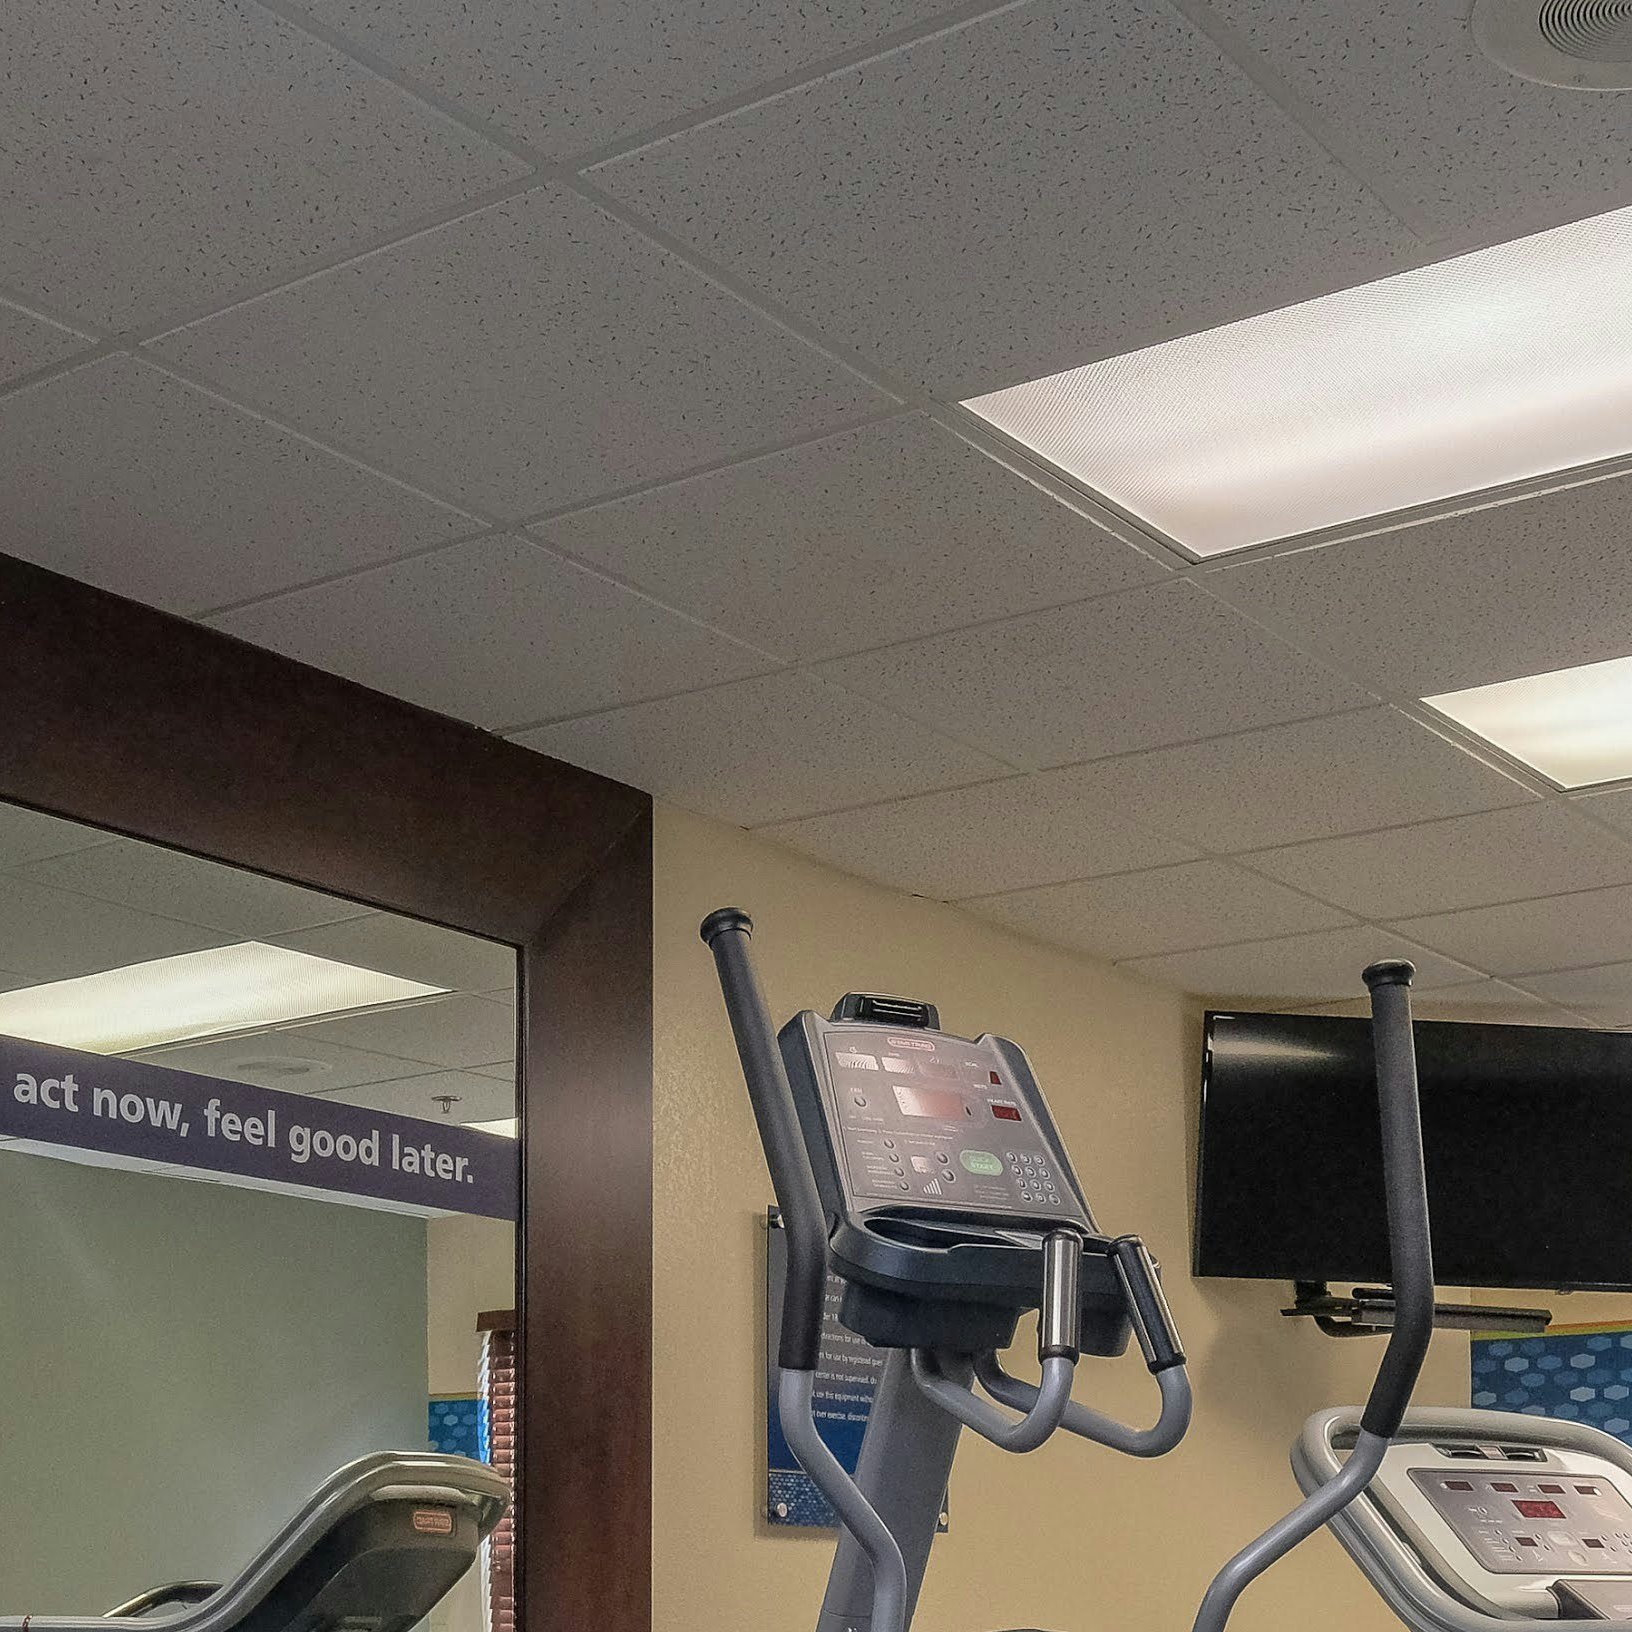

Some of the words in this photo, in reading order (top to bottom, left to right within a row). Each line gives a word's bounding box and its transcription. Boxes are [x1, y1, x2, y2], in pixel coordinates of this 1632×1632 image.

[13, 1071, 79, 1113] act
[93, 1087, 189, 1138] now,
[204, 1098, 276, 1148] feel
[288, 1124, 380, 1164] good
[392, 1134, 475, 1184] later.
